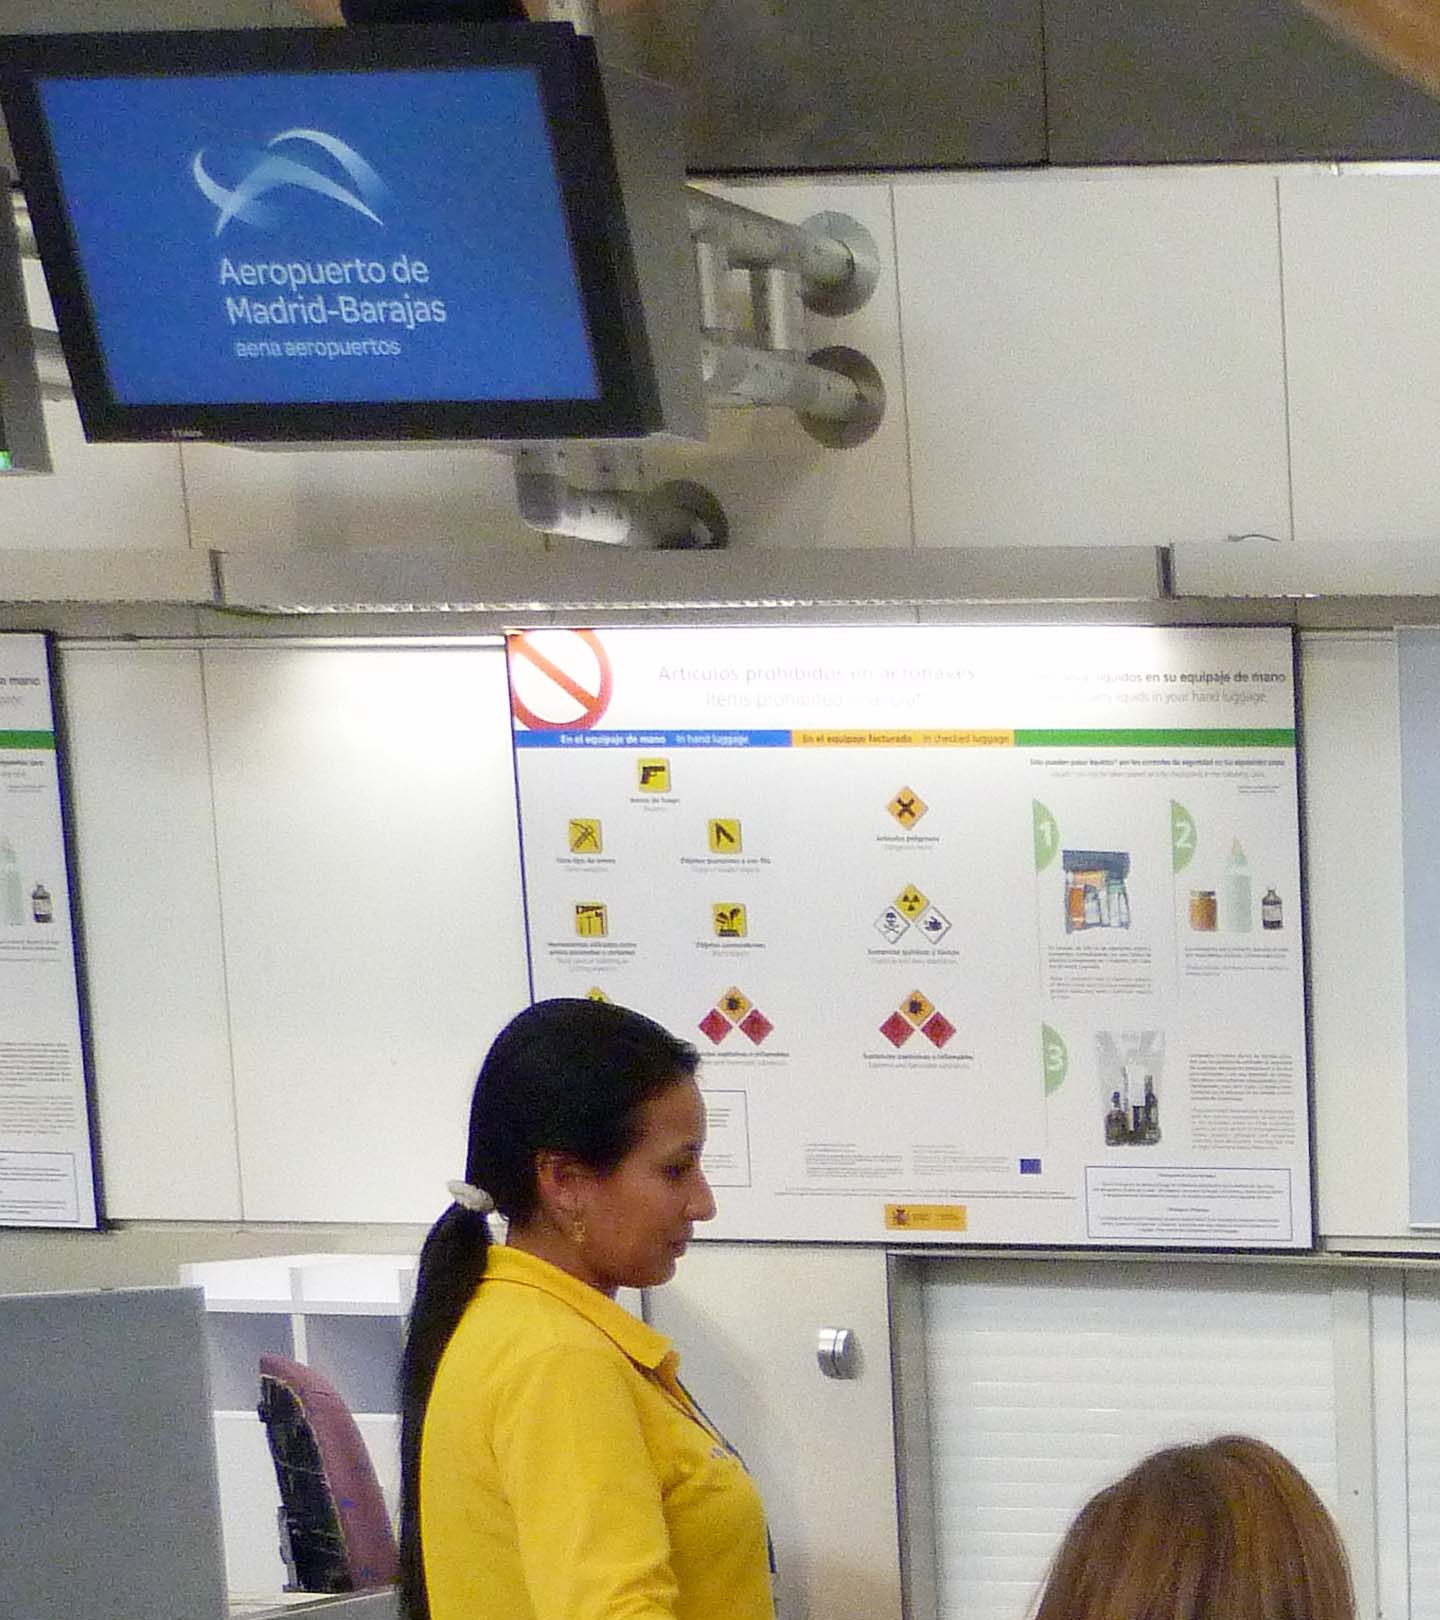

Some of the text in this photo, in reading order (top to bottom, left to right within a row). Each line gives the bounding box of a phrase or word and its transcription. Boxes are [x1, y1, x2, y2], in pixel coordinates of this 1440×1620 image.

[220, 256, 429, 290] Aeropuerto de
[226, 293, 446, 329] Madrid-Barajas
[235, 338, 401, 357] aena aeropuertos
[1146, 673, 1160, 683] en
[1163, 673, 1177, 683] su
[1180, 671, 1231, 686] equipaje
[1233, 671, 1249, 683] de
[1251, 673, 1286, 683] mano
[560, 734, 666, 747] En el equipaje de mano
[687, 734, 708, 744] hand
[802, 734, 814, 744] En
[816, 734, 824, 744] el
[1040, 822, 1054, 846] 1
[1176, 823, 1192, 849] 2
[1045, 1046, 1063, 1071] 3
